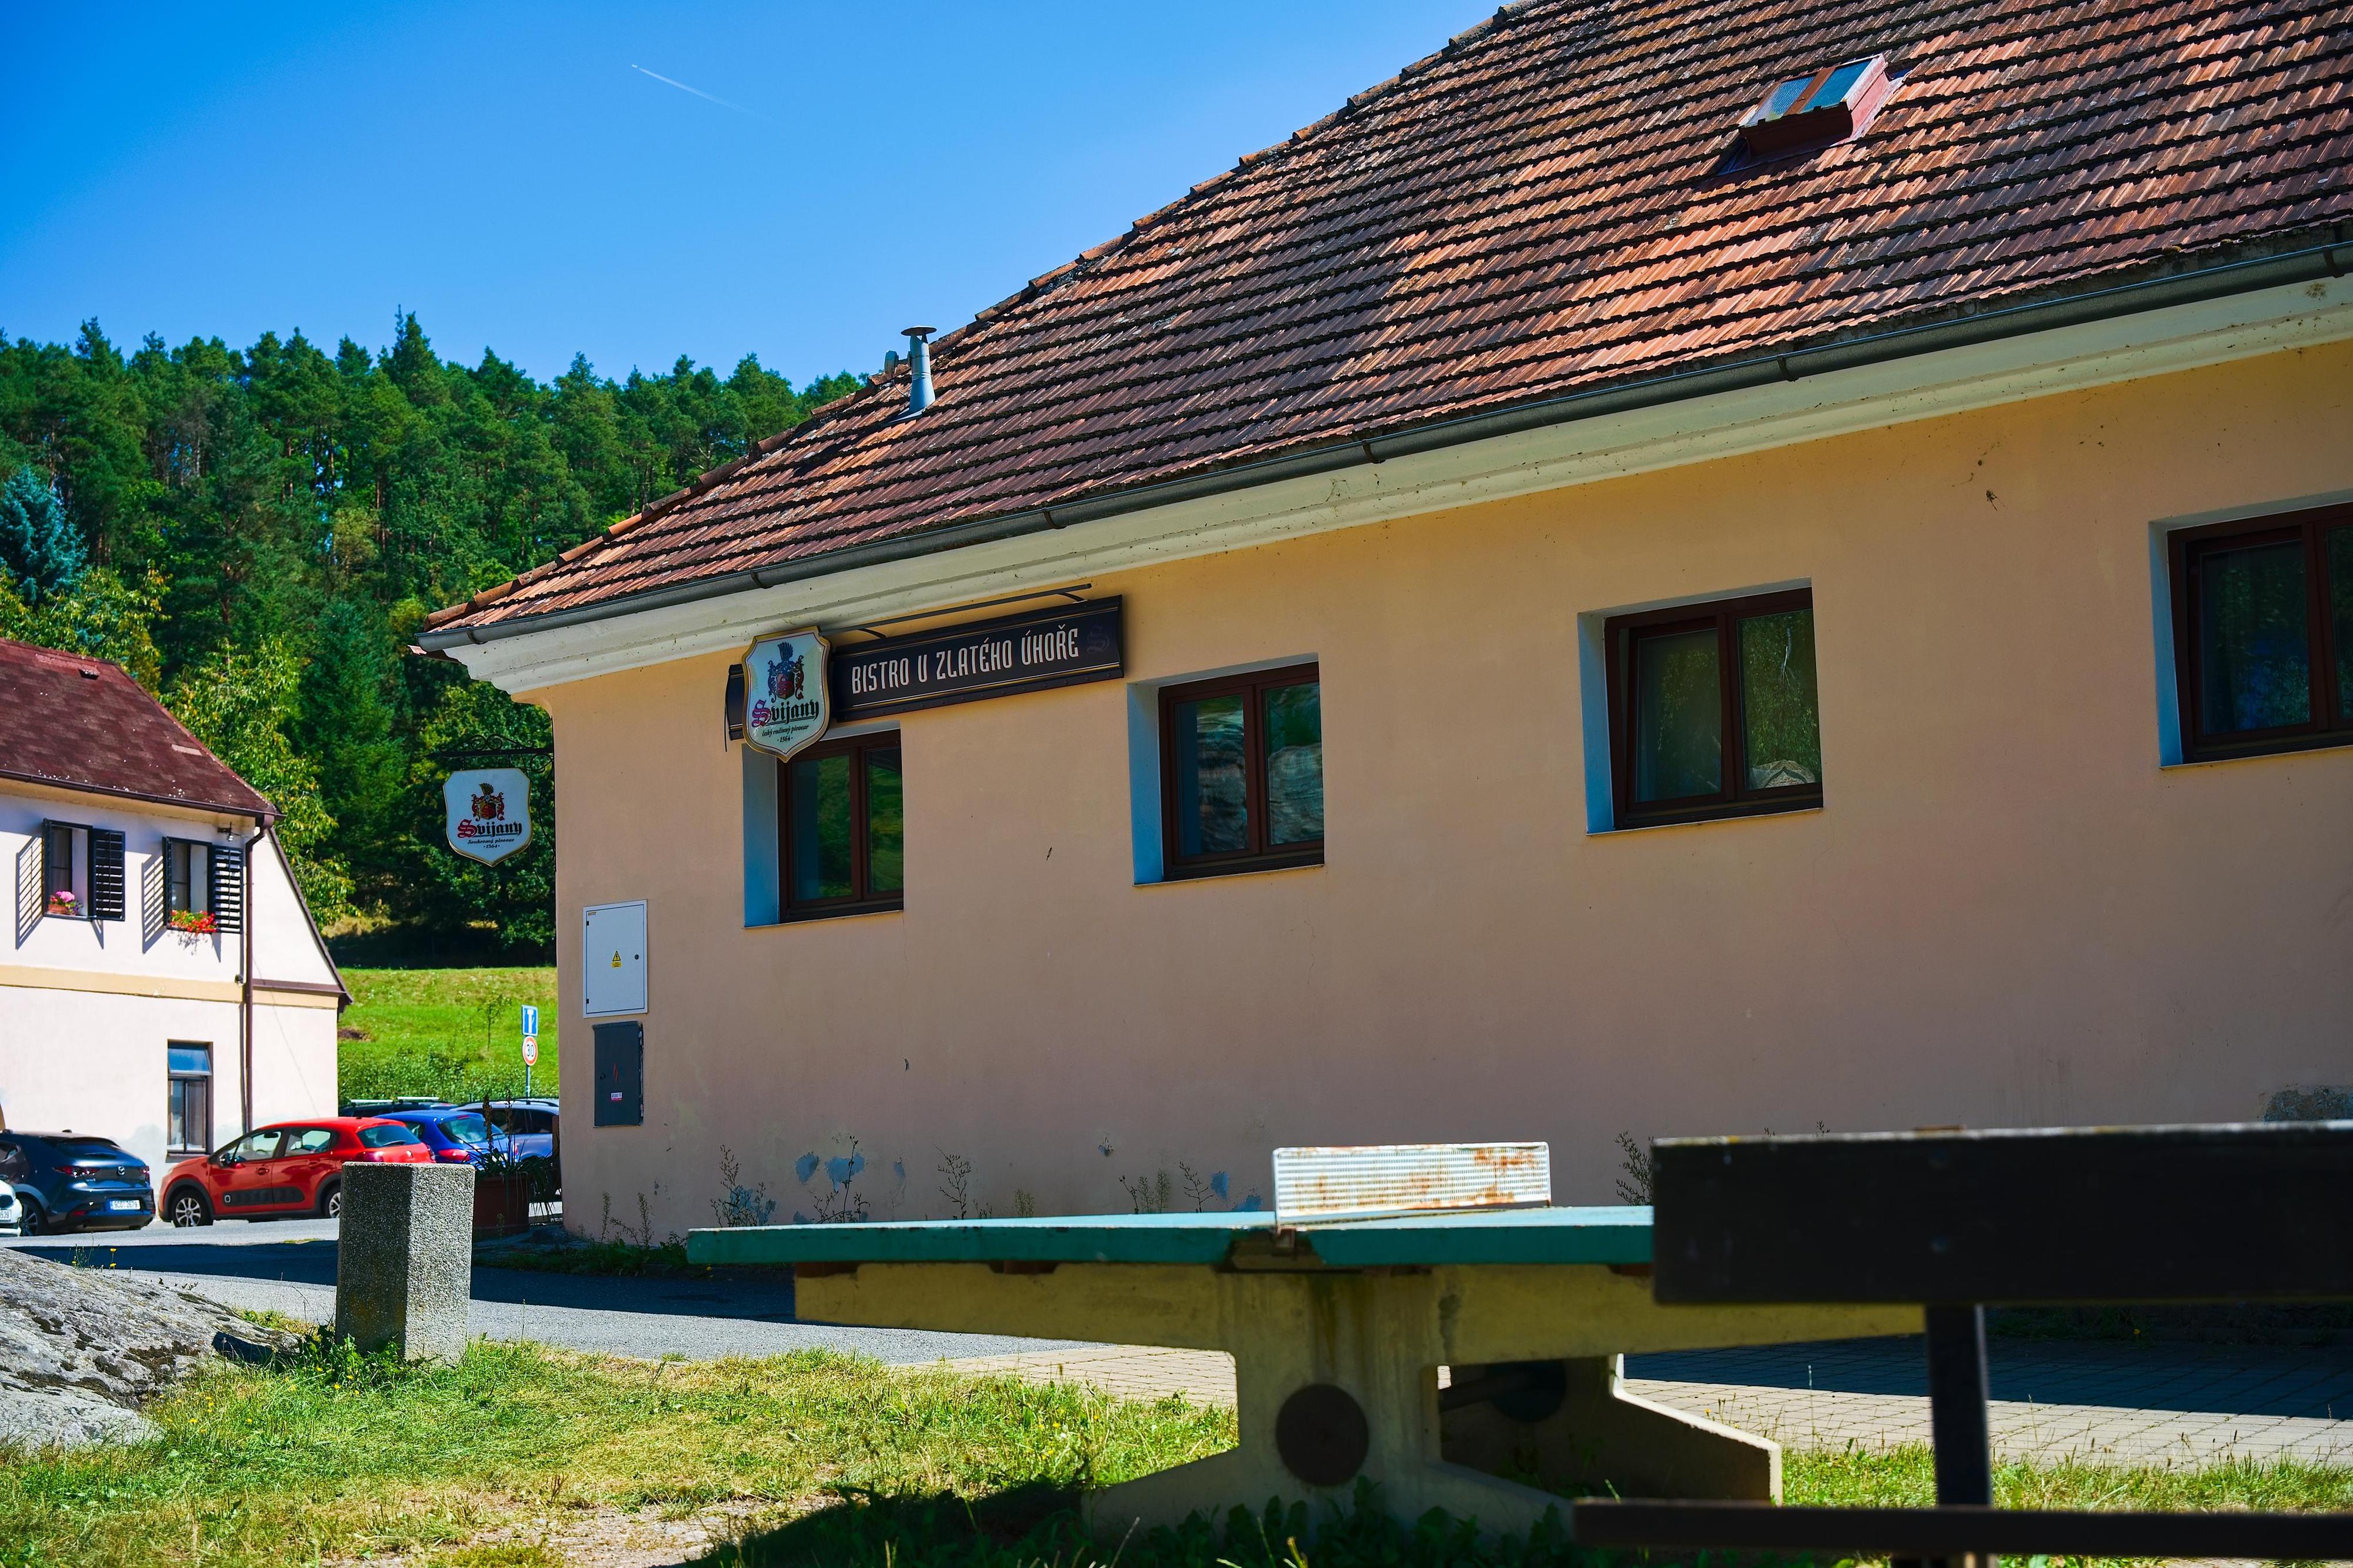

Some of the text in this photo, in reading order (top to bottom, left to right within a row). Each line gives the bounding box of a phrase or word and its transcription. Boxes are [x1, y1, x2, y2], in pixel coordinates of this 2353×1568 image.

[852, 623, 1079, 695] BISTRO U ZLATÉHO ÚHOŘE
[752, 699, 819, 728] Svijany
[773, 726, 791, 734] rodinný
[791, 725, 809, 733] pivovar
[458, 819, 522, 838] Svijany
[526, 1044, 534, 1057] 30
